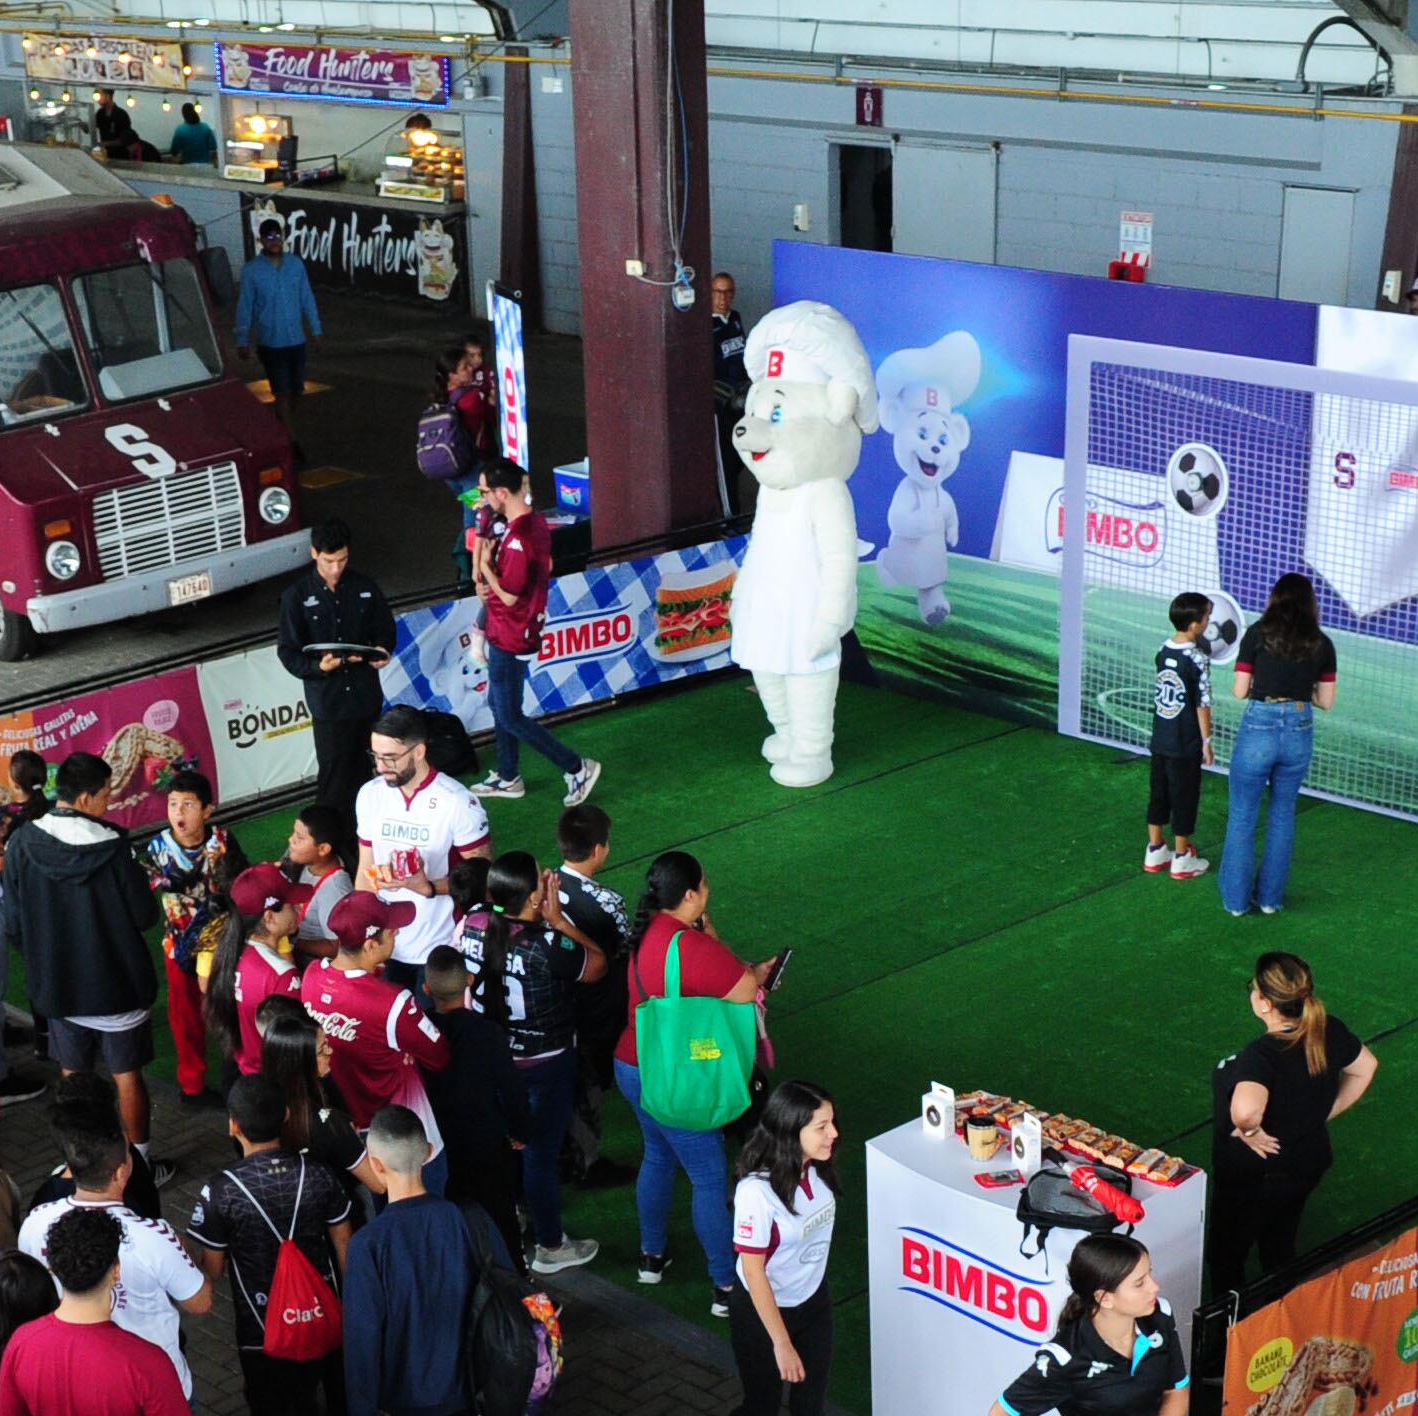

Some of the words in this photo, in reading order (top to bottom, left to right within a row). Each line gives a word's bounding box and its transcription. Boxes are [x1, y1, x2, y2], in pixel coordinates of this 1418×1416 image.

[264, 47, 316, 80] Food
[318, 48, 395, 84] Hunters
[287, 209, 337, 269] Food
[342, 210, 418, 284] Hunters
[766, 350, 785, 378] B
[105, 423, 177, 480] S
[1333, 452, 1357, 490] S
[536, 613, 633, 663] BIMBO
[33, 733, 59, 753] REAL
[59, 728, 69, 741] Y
[380, 821, 431, 842] BIMBO
[902, 1236, 1049, 1333] BIMBO
[1372, 1274, 1406, 1302] FRUTA
